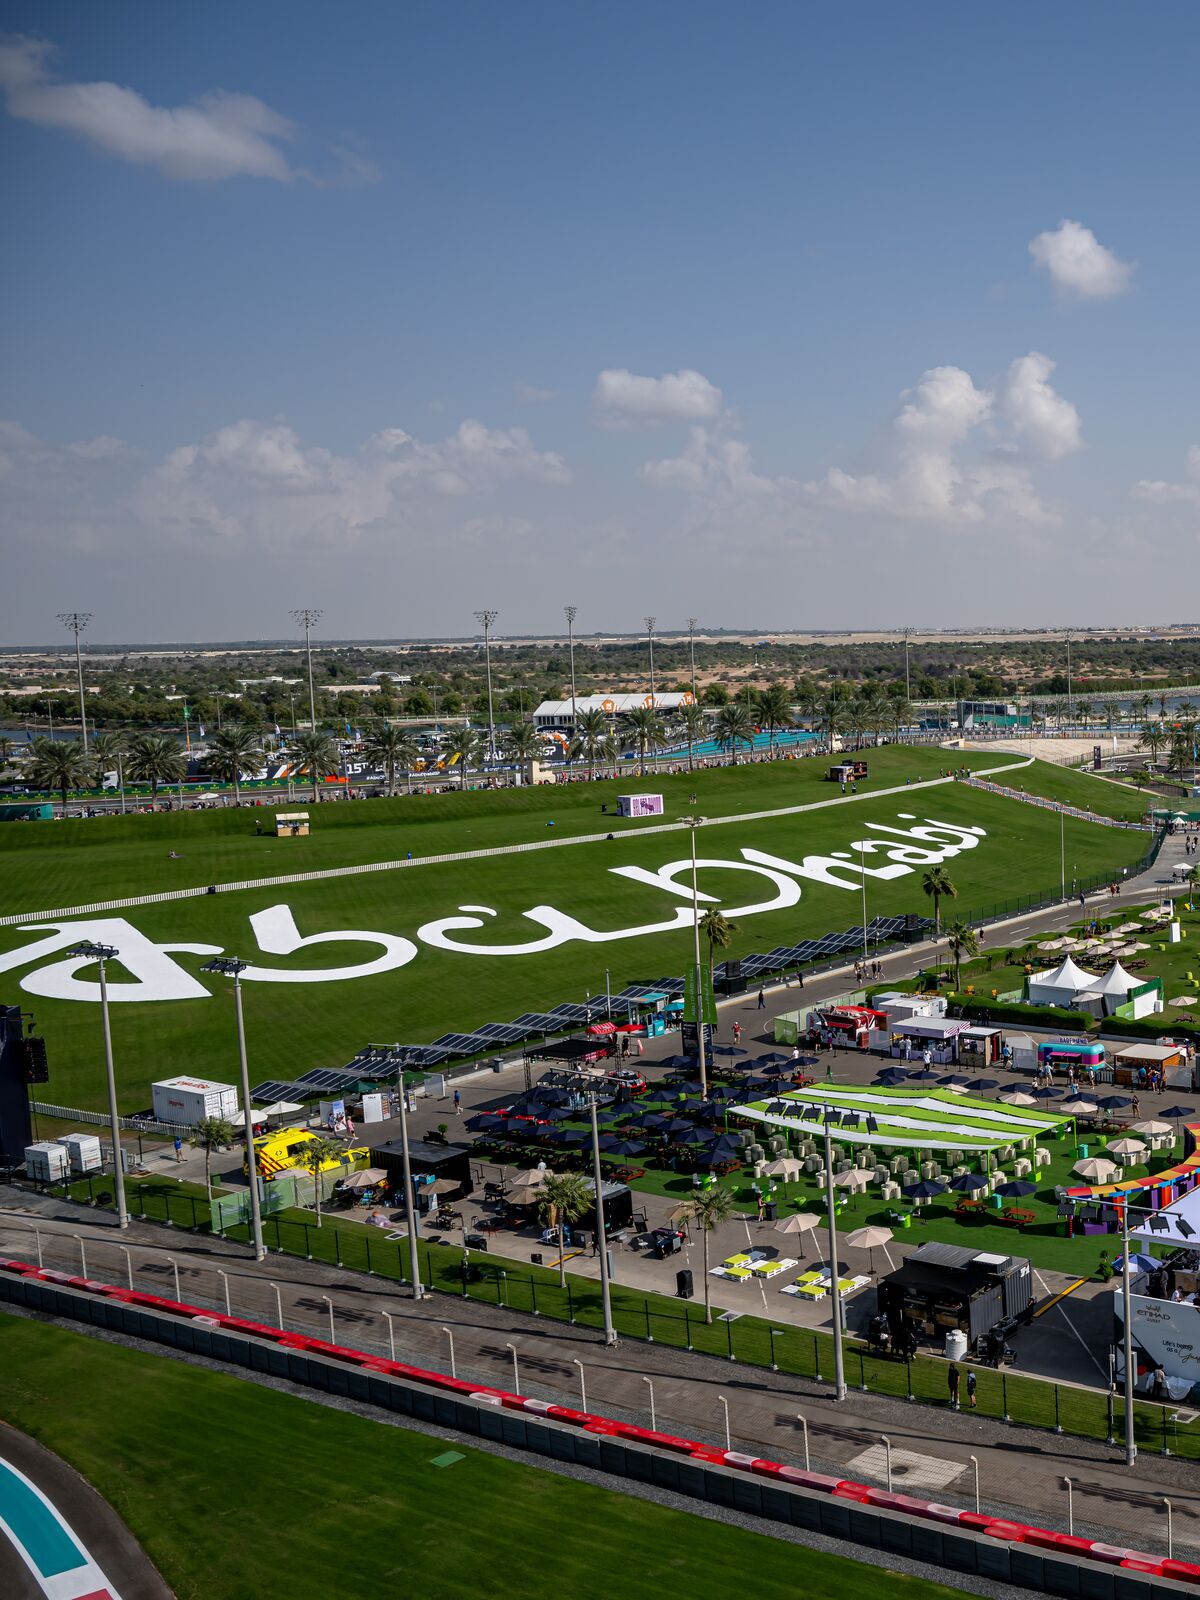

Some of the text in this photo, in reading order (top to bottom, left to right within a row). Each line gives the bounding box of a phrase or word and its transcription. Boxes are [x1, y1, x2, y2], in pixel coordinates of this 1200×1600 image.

[0, 811, 988, 1002] Abu Dhabi
[1136, 1309, 1171, 1321] ETIHAD
